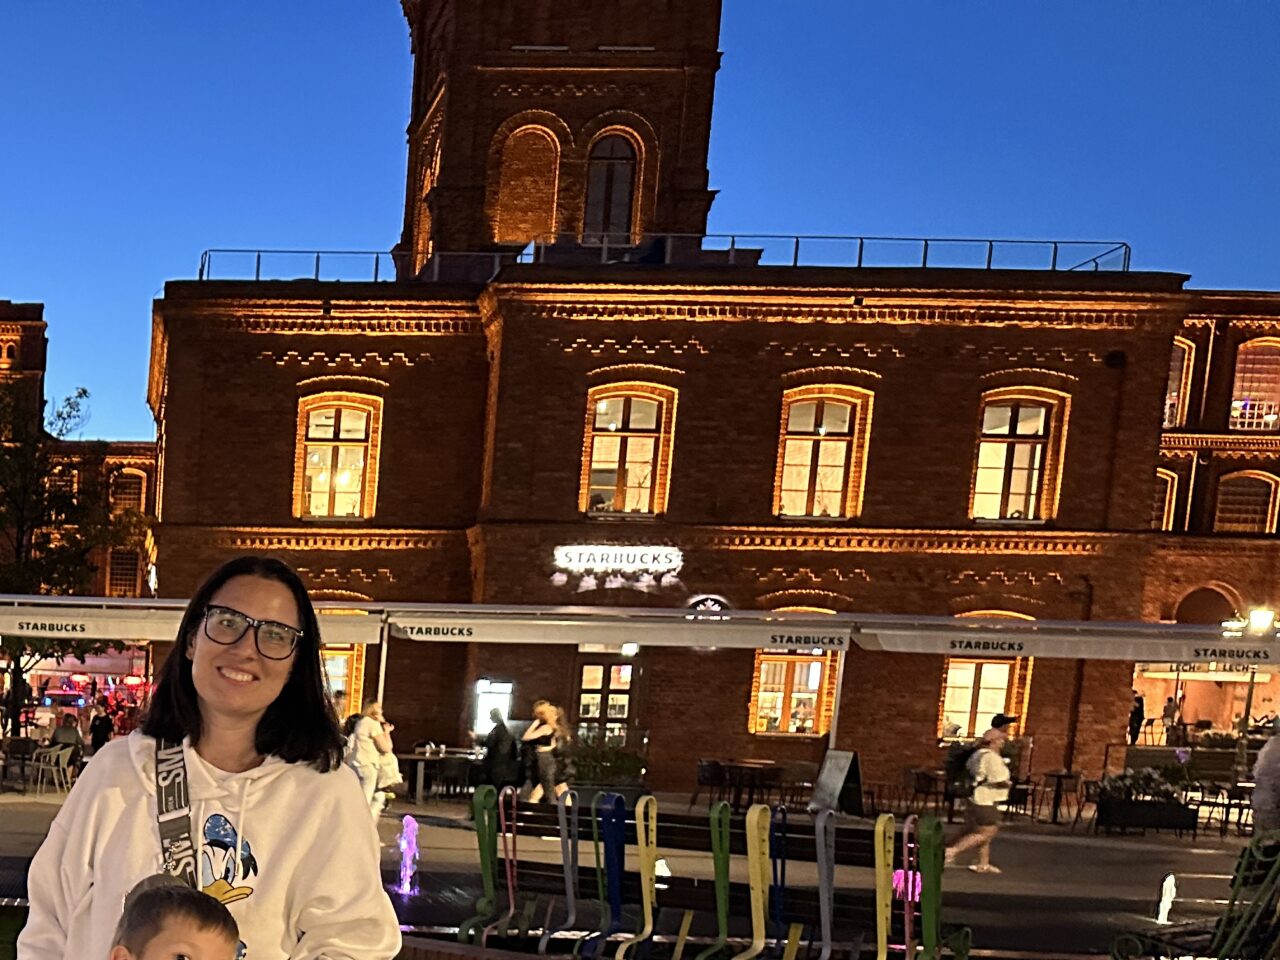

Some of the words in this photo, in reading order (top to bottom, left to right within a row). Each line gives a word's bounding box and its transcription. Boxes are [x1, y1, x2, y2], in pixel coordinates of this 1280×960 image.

[563, 550, 674, 565] STARBUCKS
[17, 621, 86, 633] STARBUCKS
[402, 625, 473, 637] STARBUCKS
[770, 634, 844, 646] STARBUCKS
[949, 639, 1025, 652] STARBUCKS
[1193, 648, 1270, 660] STARBUCKS
